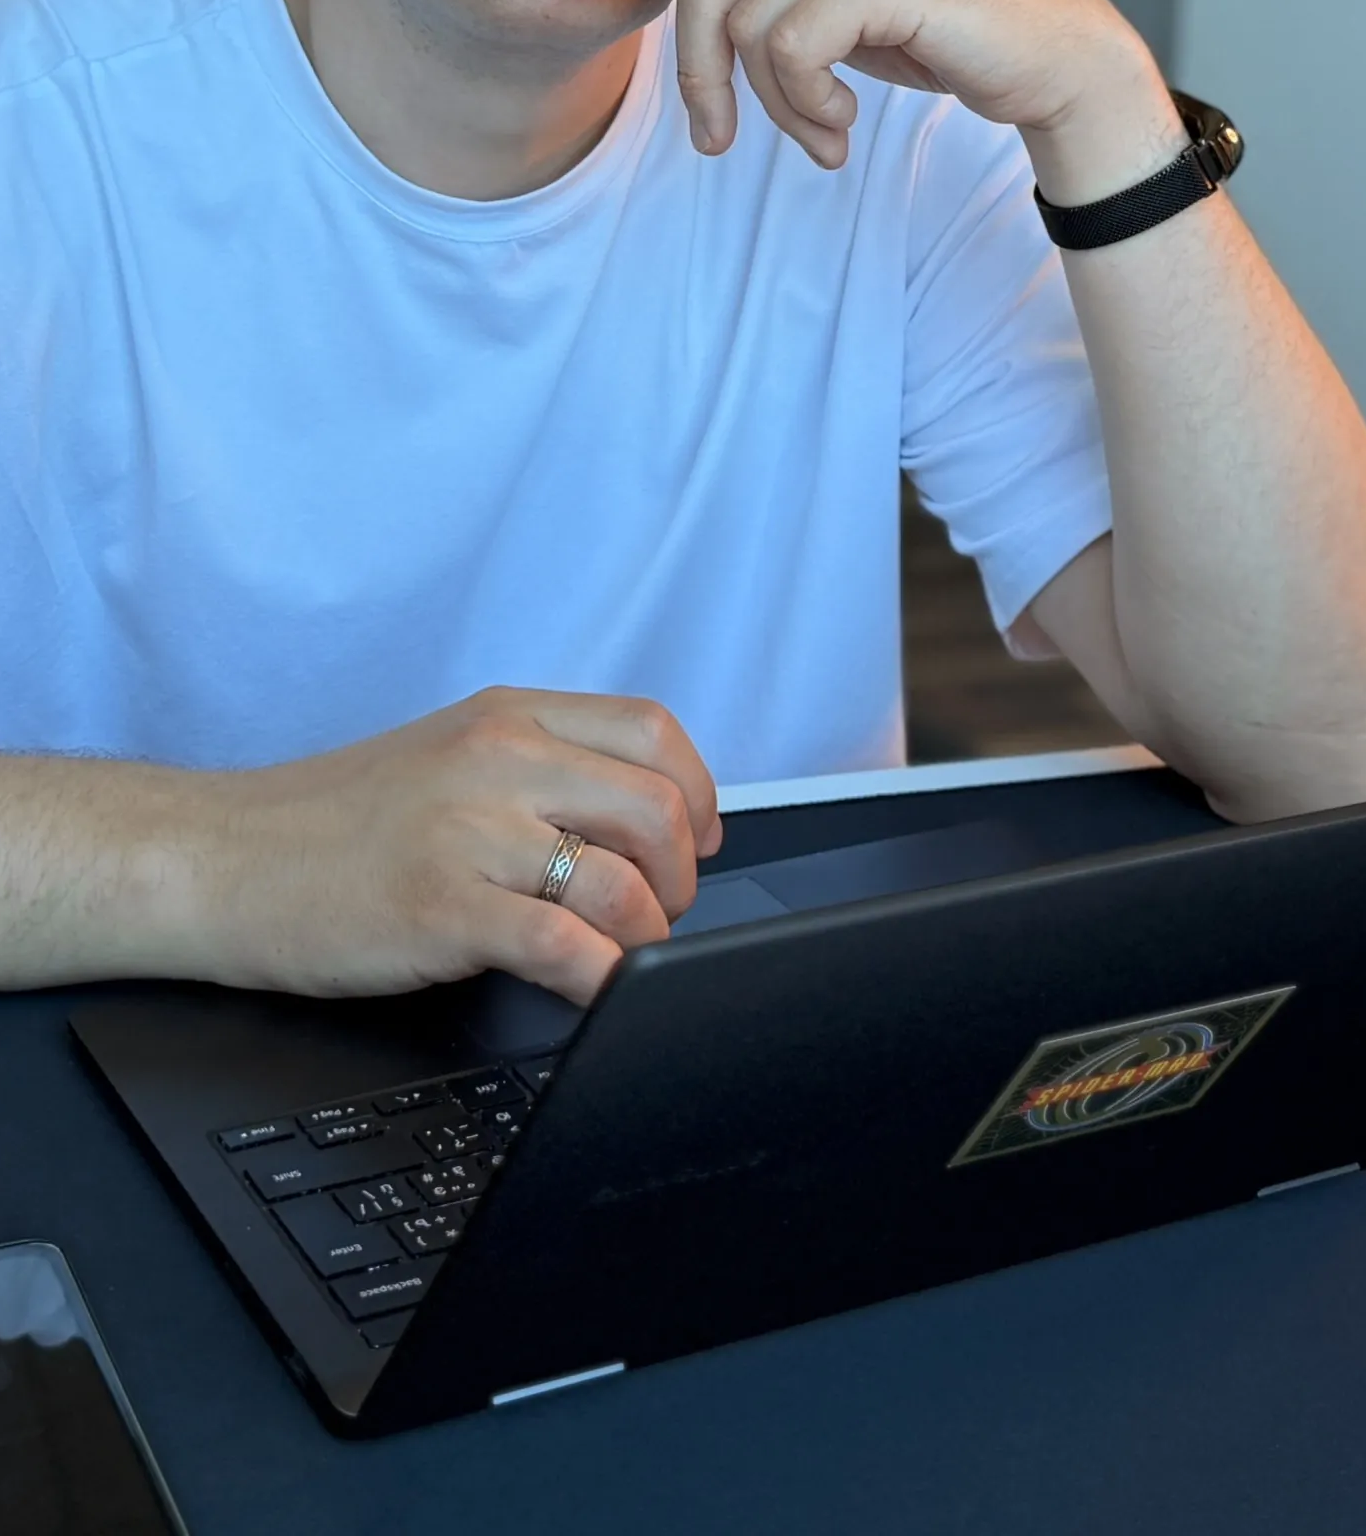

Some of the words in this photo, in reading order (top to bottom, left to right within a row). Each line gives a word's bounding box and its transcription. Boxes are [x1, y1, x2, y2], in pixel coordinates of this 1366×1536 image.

[1035, 1052, 1205, 1106] SPIDER-MAN
[272, 1169, 302, 1182] Shift
[330, 1243, 363, 1256] Enter
[359, 1277, 423, 1298] Backspace
